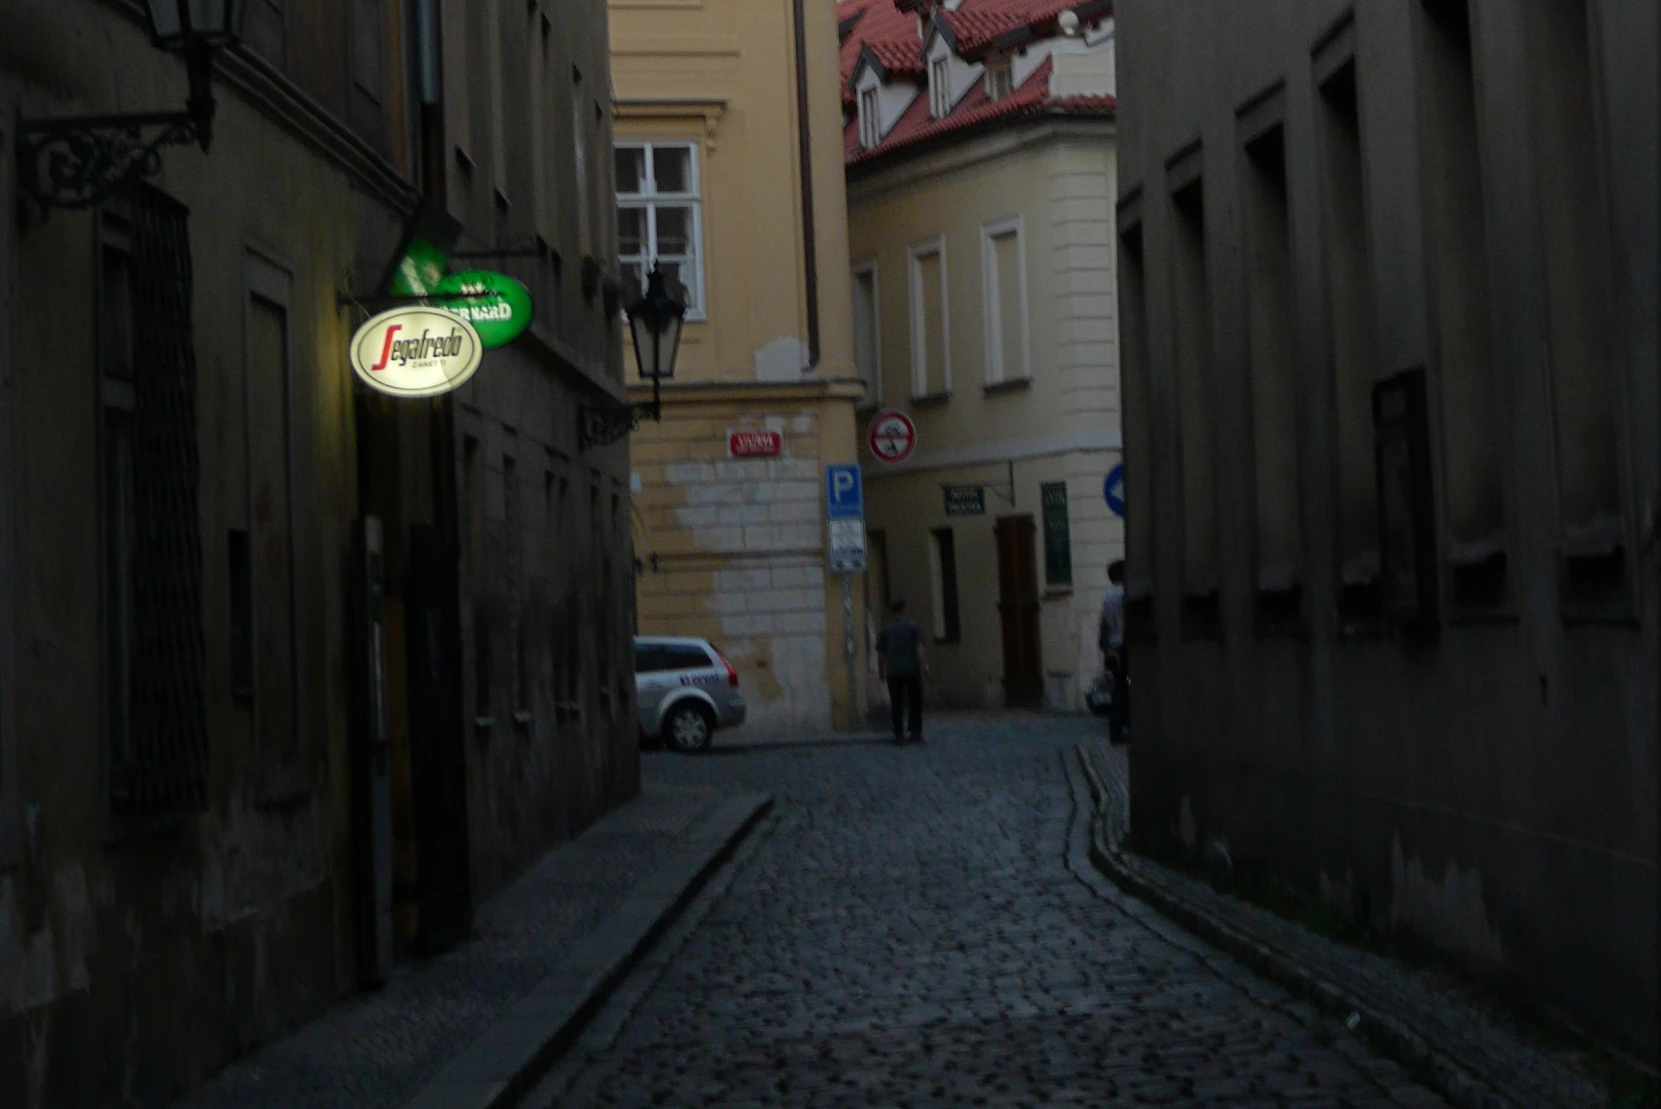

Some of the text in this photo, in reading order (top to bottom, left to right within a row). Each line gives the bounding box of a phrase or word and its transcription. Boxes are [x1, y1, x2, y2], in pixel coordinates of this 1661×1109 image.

[440, 302, 512, 321] RNARD
[371, 324, 462, 371] Segafredo
[834, 470, 854, 501] P
